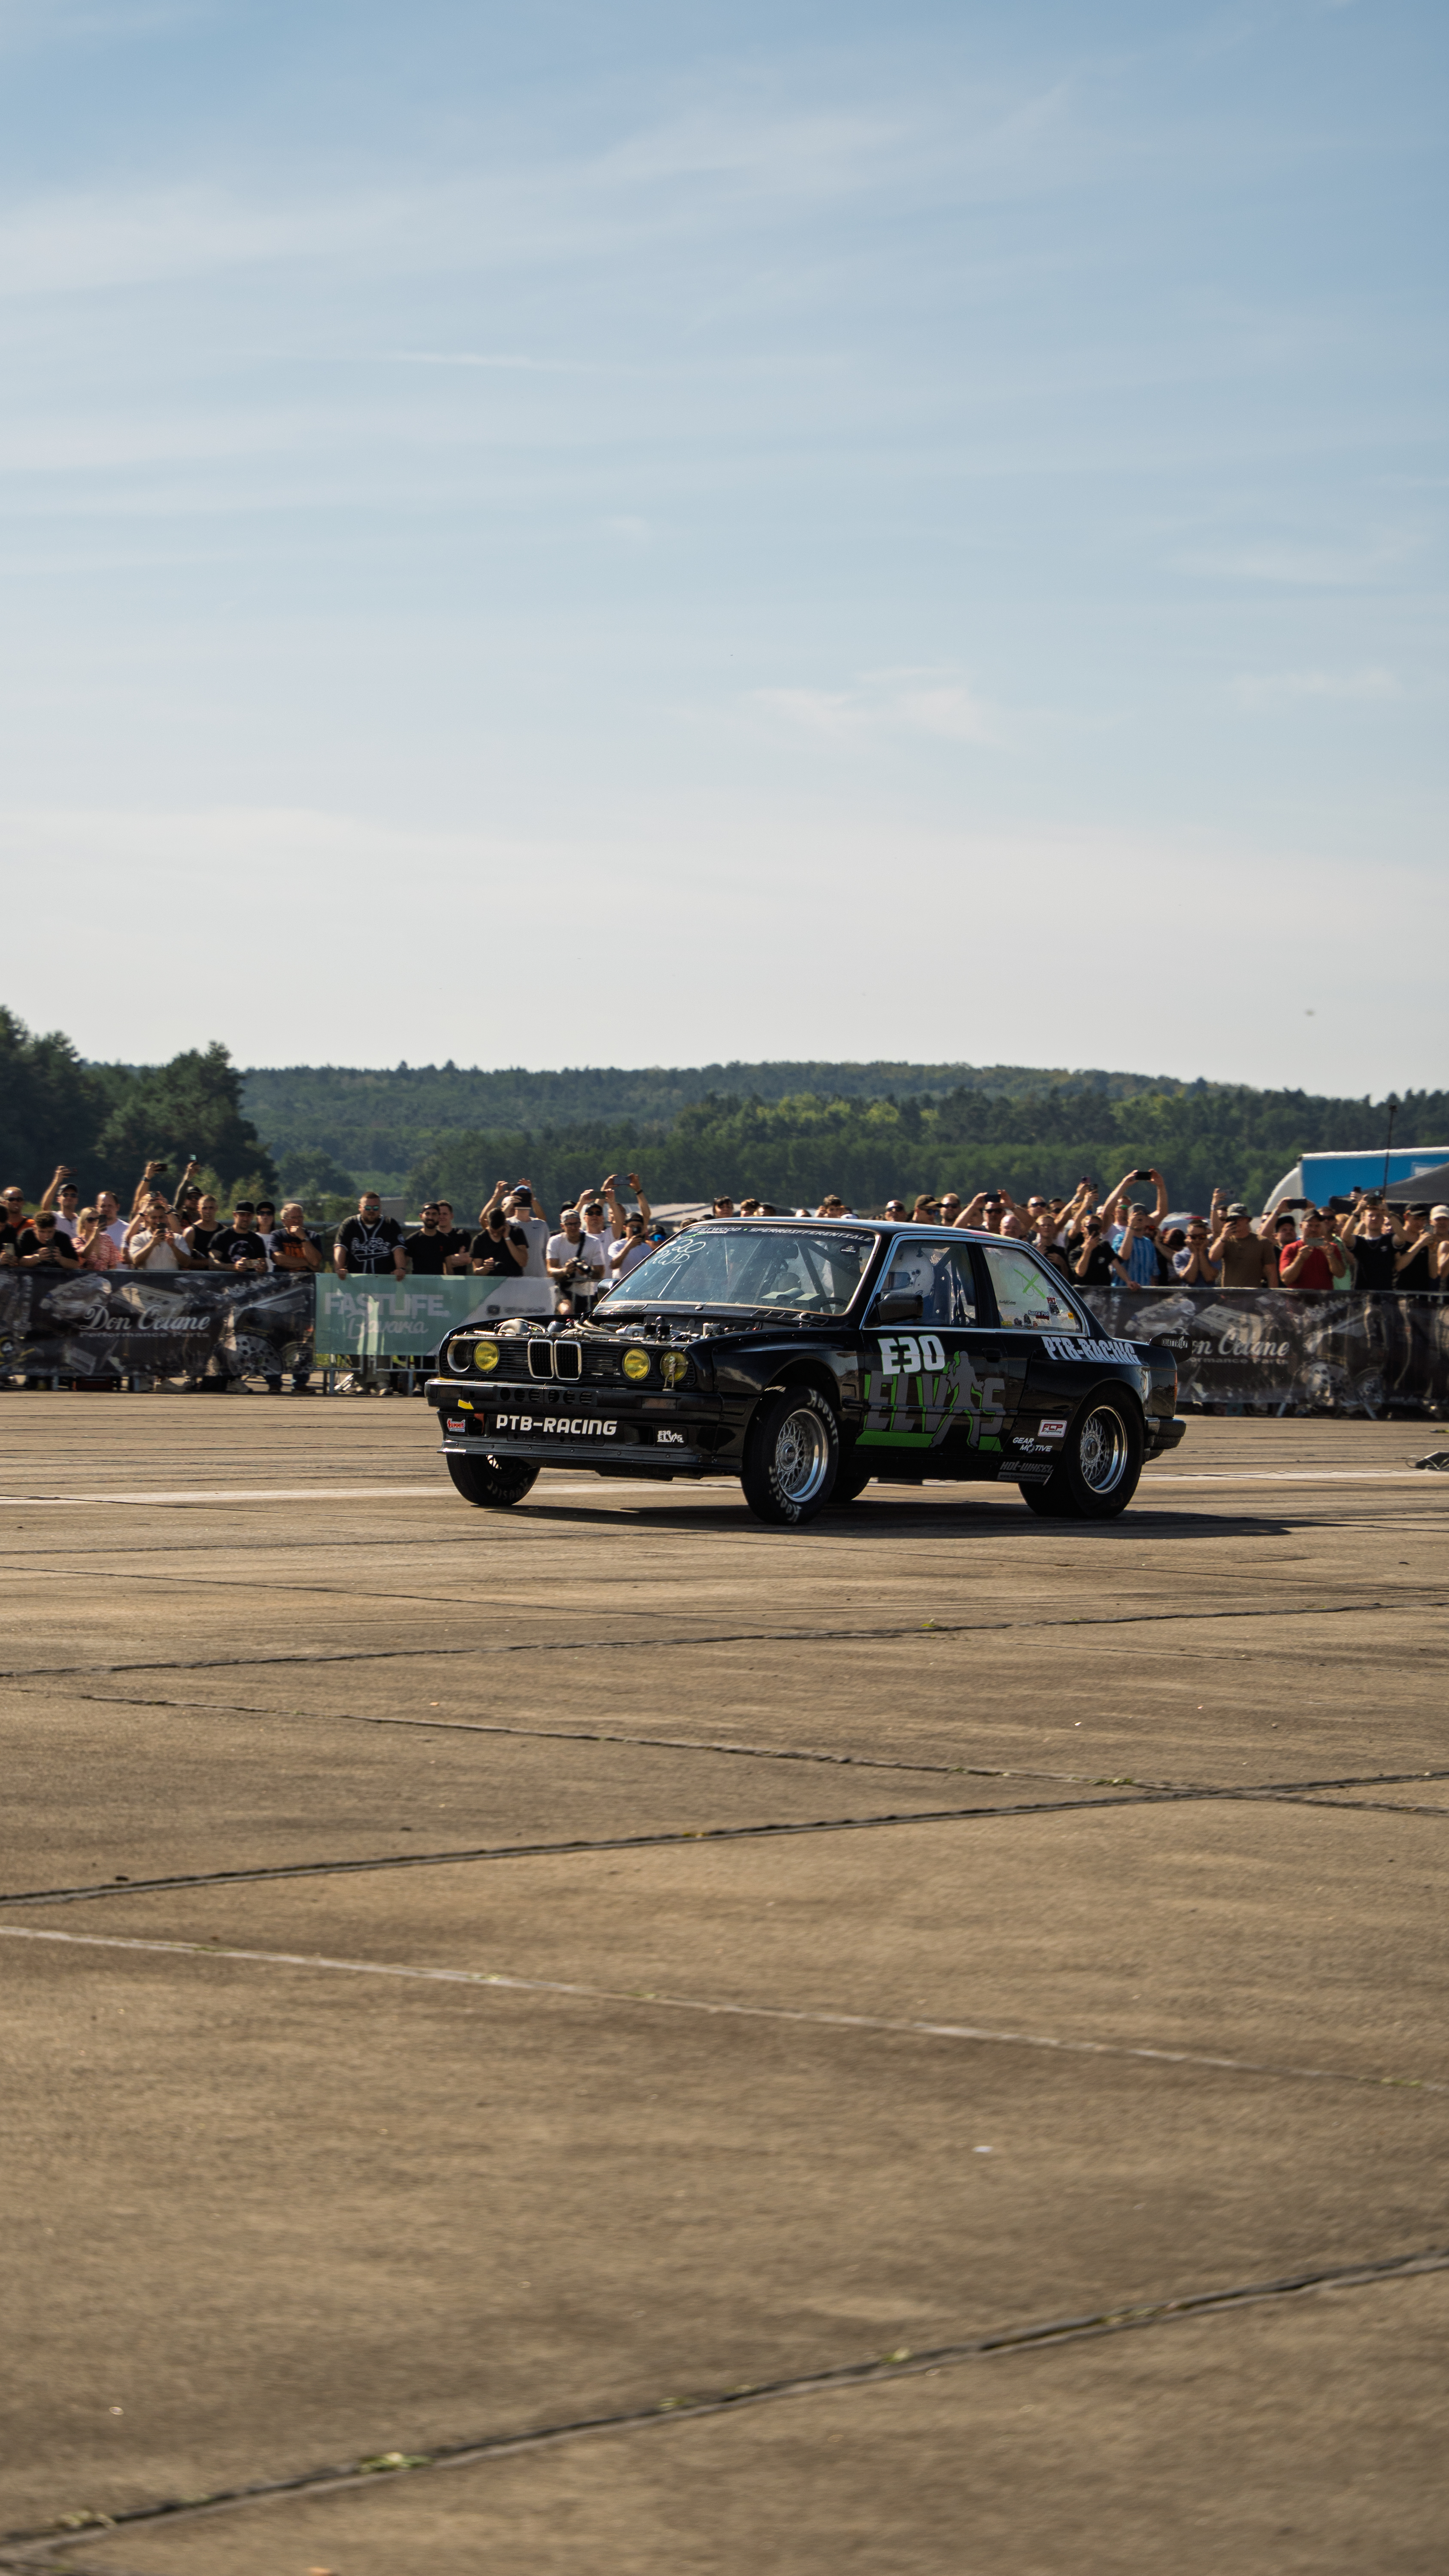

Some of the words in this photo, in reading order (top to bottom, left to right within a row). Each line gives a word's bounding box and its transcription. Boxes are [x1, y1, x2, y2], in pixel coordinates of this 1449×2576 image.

[748, 1228, 875, 1242] SPERRDIFFERENTIALE
[79, 1304, 132, 1330] Don
[878, 1335, 946, 1375] E30
[1041, 1336, 1145, 1366] PTB-RACING
[1192, 1340, 1213, 1355] on
[496, 1414, 618, 1435] PTB-RACING
[1041, 1423, 1063, 1433] FCP
[1019, 1444, 1053, 1454] MOTIVE
